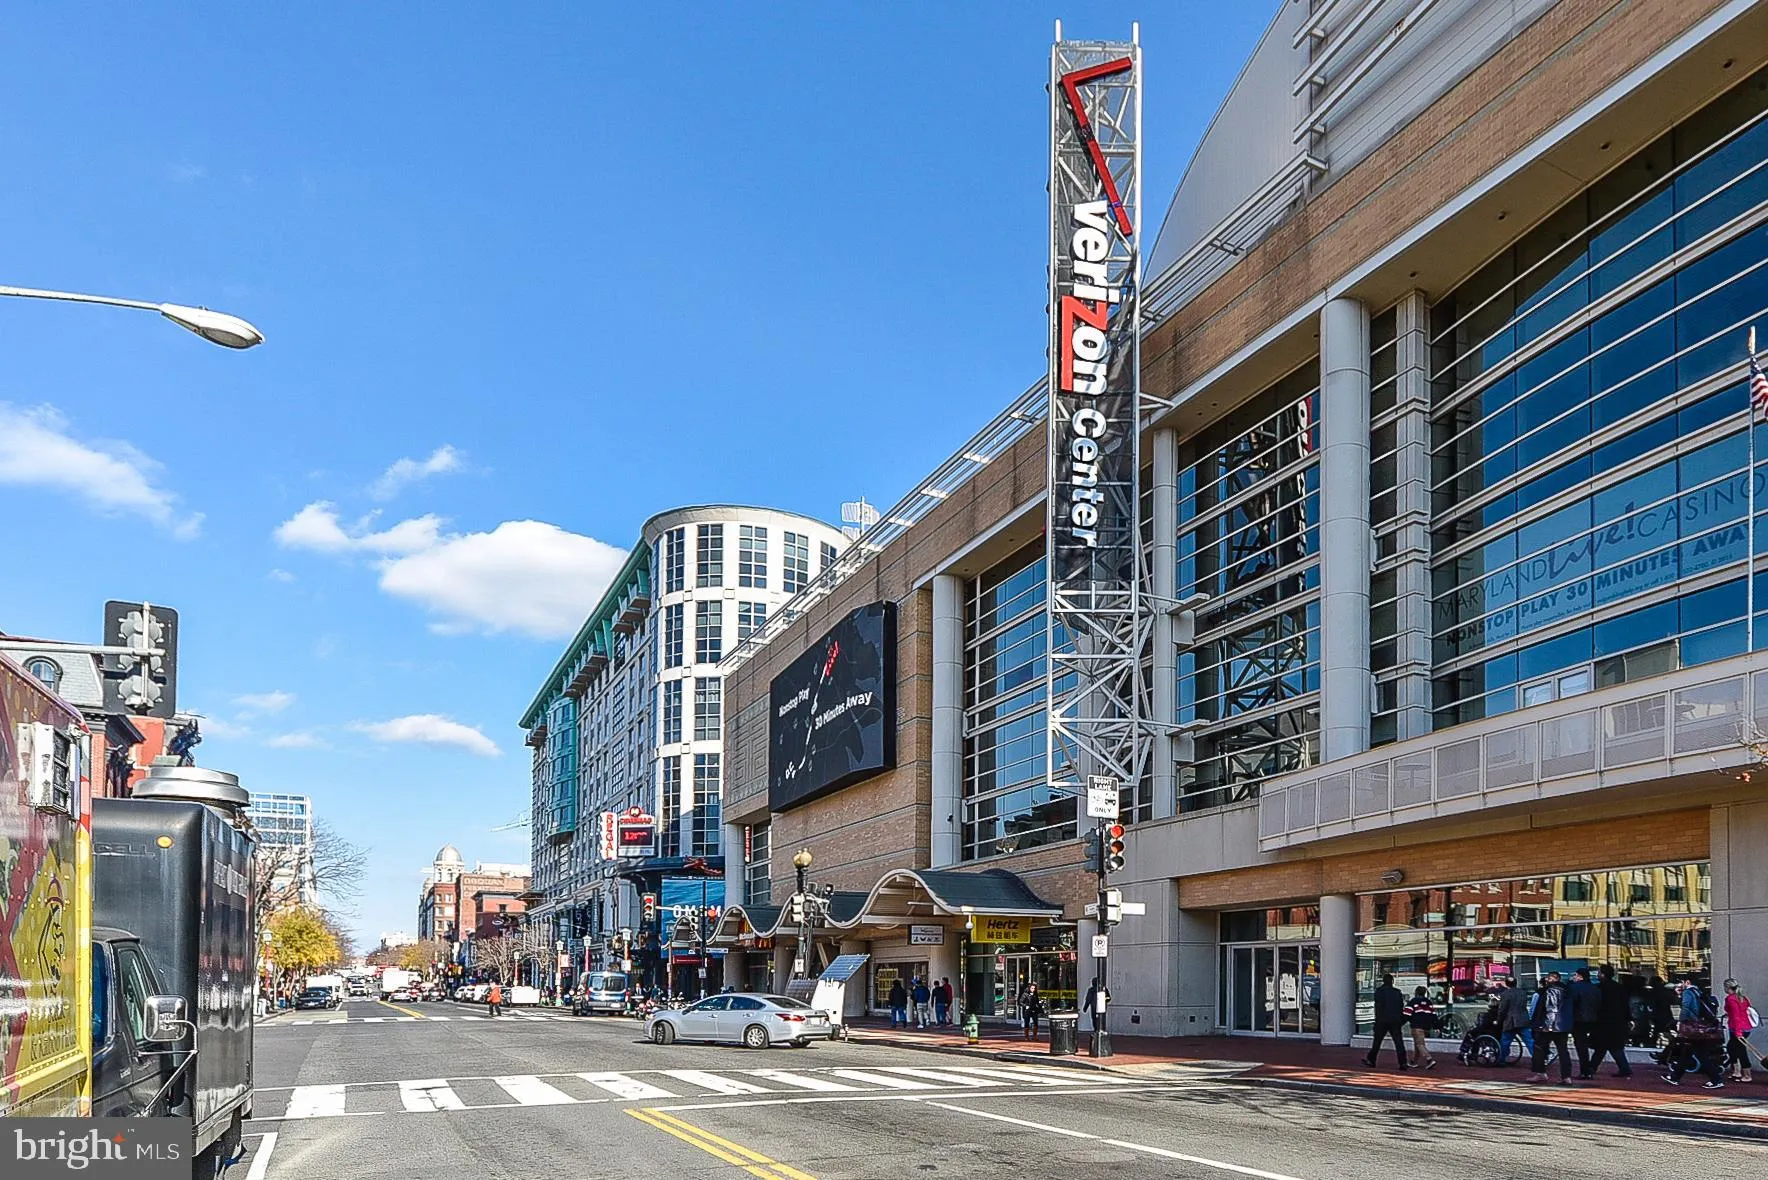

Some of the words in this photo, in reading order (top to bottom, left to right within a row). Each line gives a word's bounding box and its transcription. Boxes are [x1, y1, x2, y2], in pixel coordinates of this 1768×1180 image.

[1060, 199, 1120, 396] verizon
[1071, 407, 1106, 549] center
[1438, 558, 1548, 621] MARYLAND
[1637, 472, 1766, 538] CASINO
[1446, 609, 1514, 648] NONSTOP
[1521, 591, 1560, 618] PLAY
[1566, 581, 1589, 601] 30
[1596, 547, 1683, 591] MINUTES
[779, 696, 798, 717] Nonstop
[798, 687, 810, 703] Play
[814, 714, 823, 731] 30
[823, 702, 845, 725] Minutes
[845, 691, 873, 710] Away
[1094, 807, 1112, 815] ONLY
[987, 919, 1019, 930] Hertz
